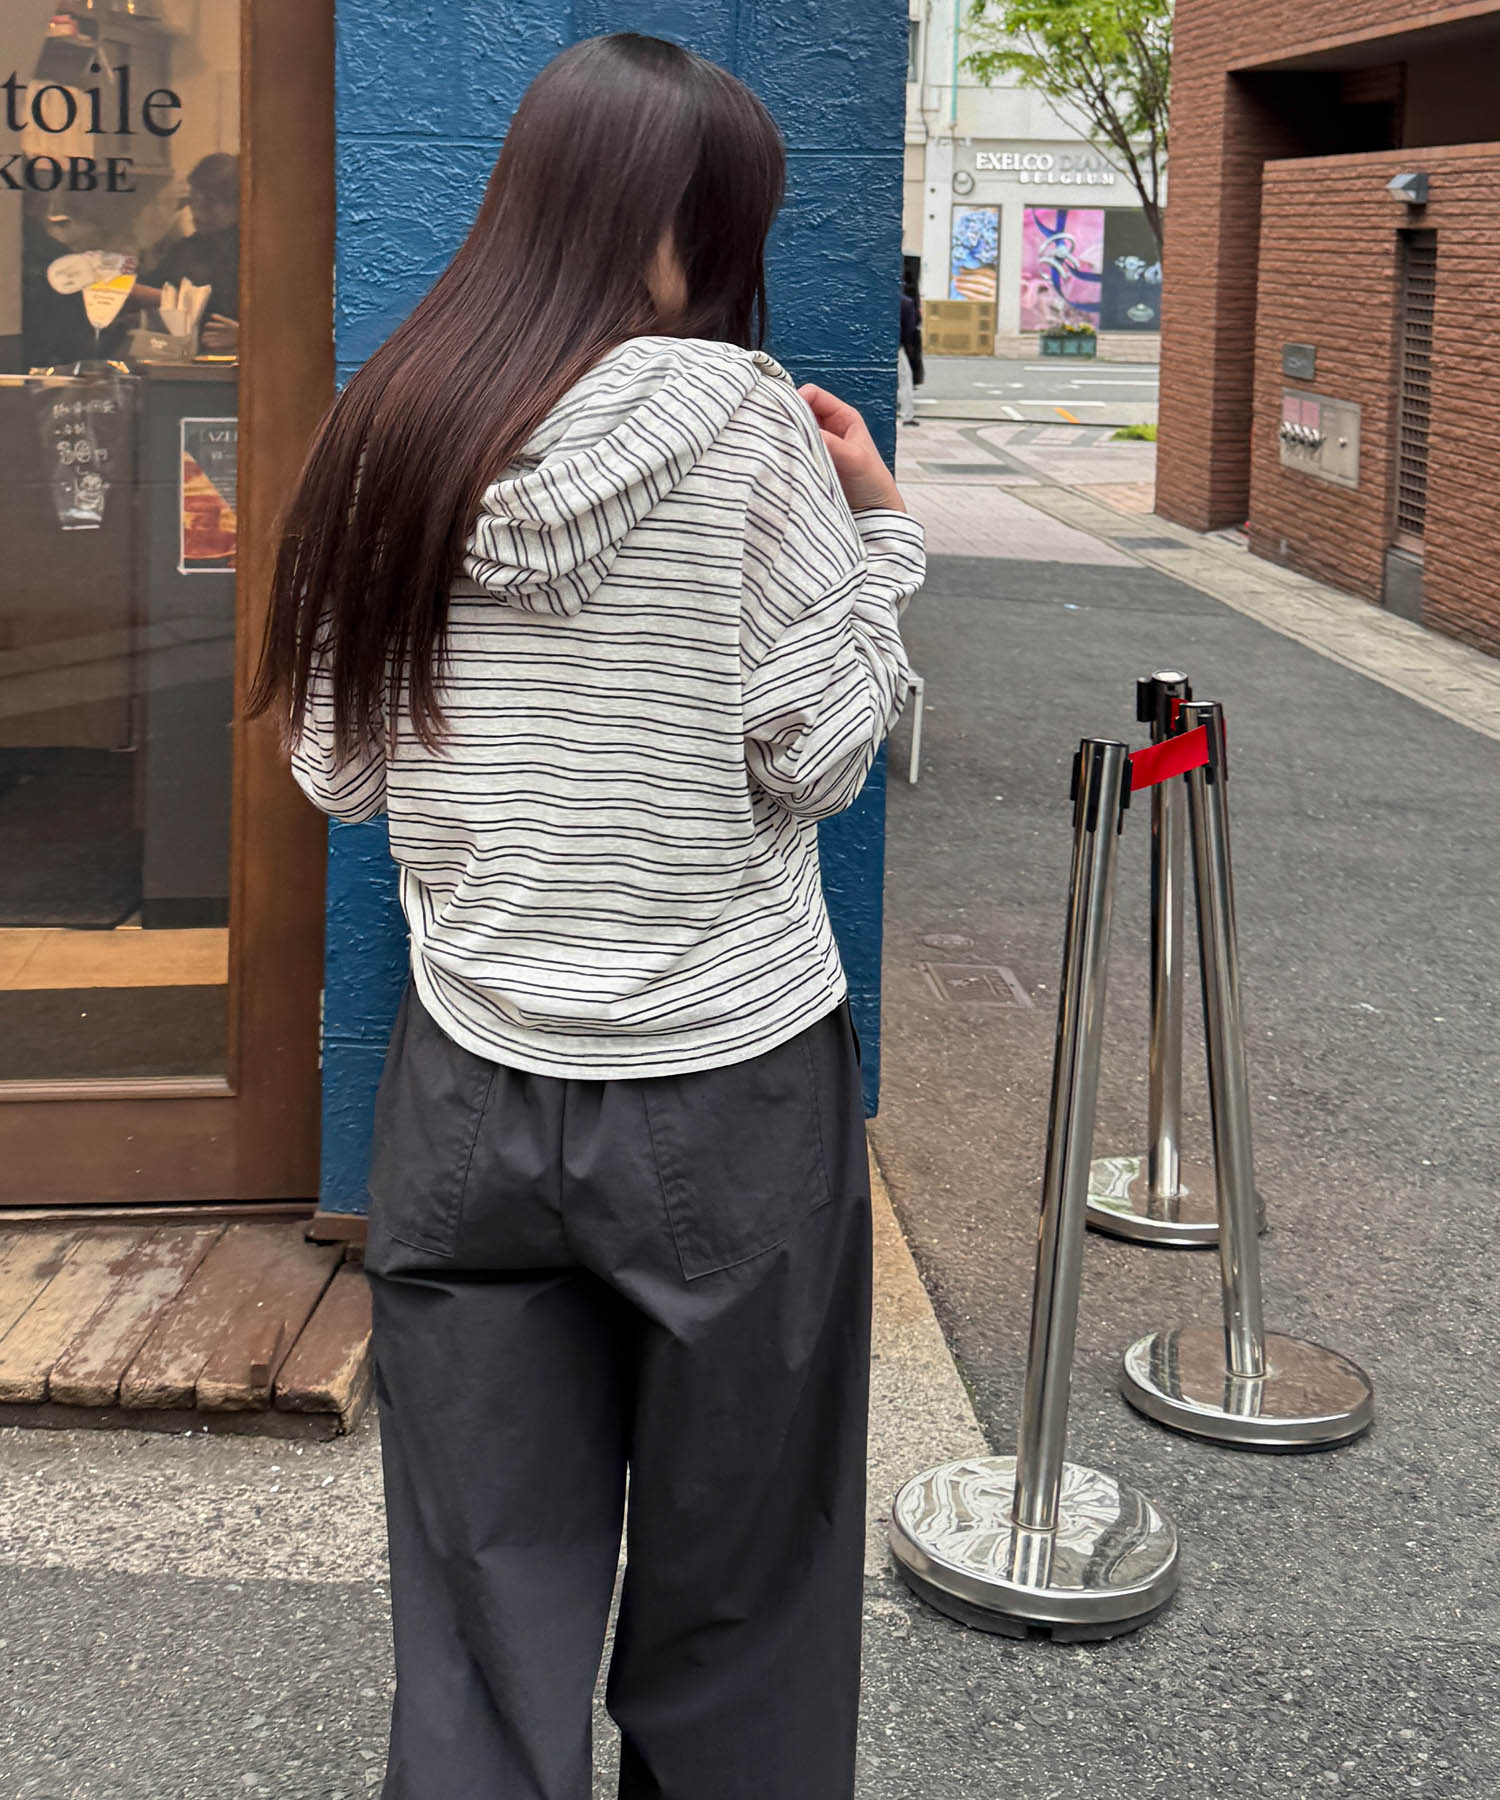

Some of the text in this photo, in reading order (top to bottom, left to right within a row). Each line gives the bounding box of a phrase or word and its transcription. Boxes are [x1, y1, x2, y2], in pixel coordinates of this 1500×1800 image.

[976, 152, 1054, 170] EXELCO
[0, 154, 137, 193] KOBE
[1019, 171, 1115, 185] BELGIUM
